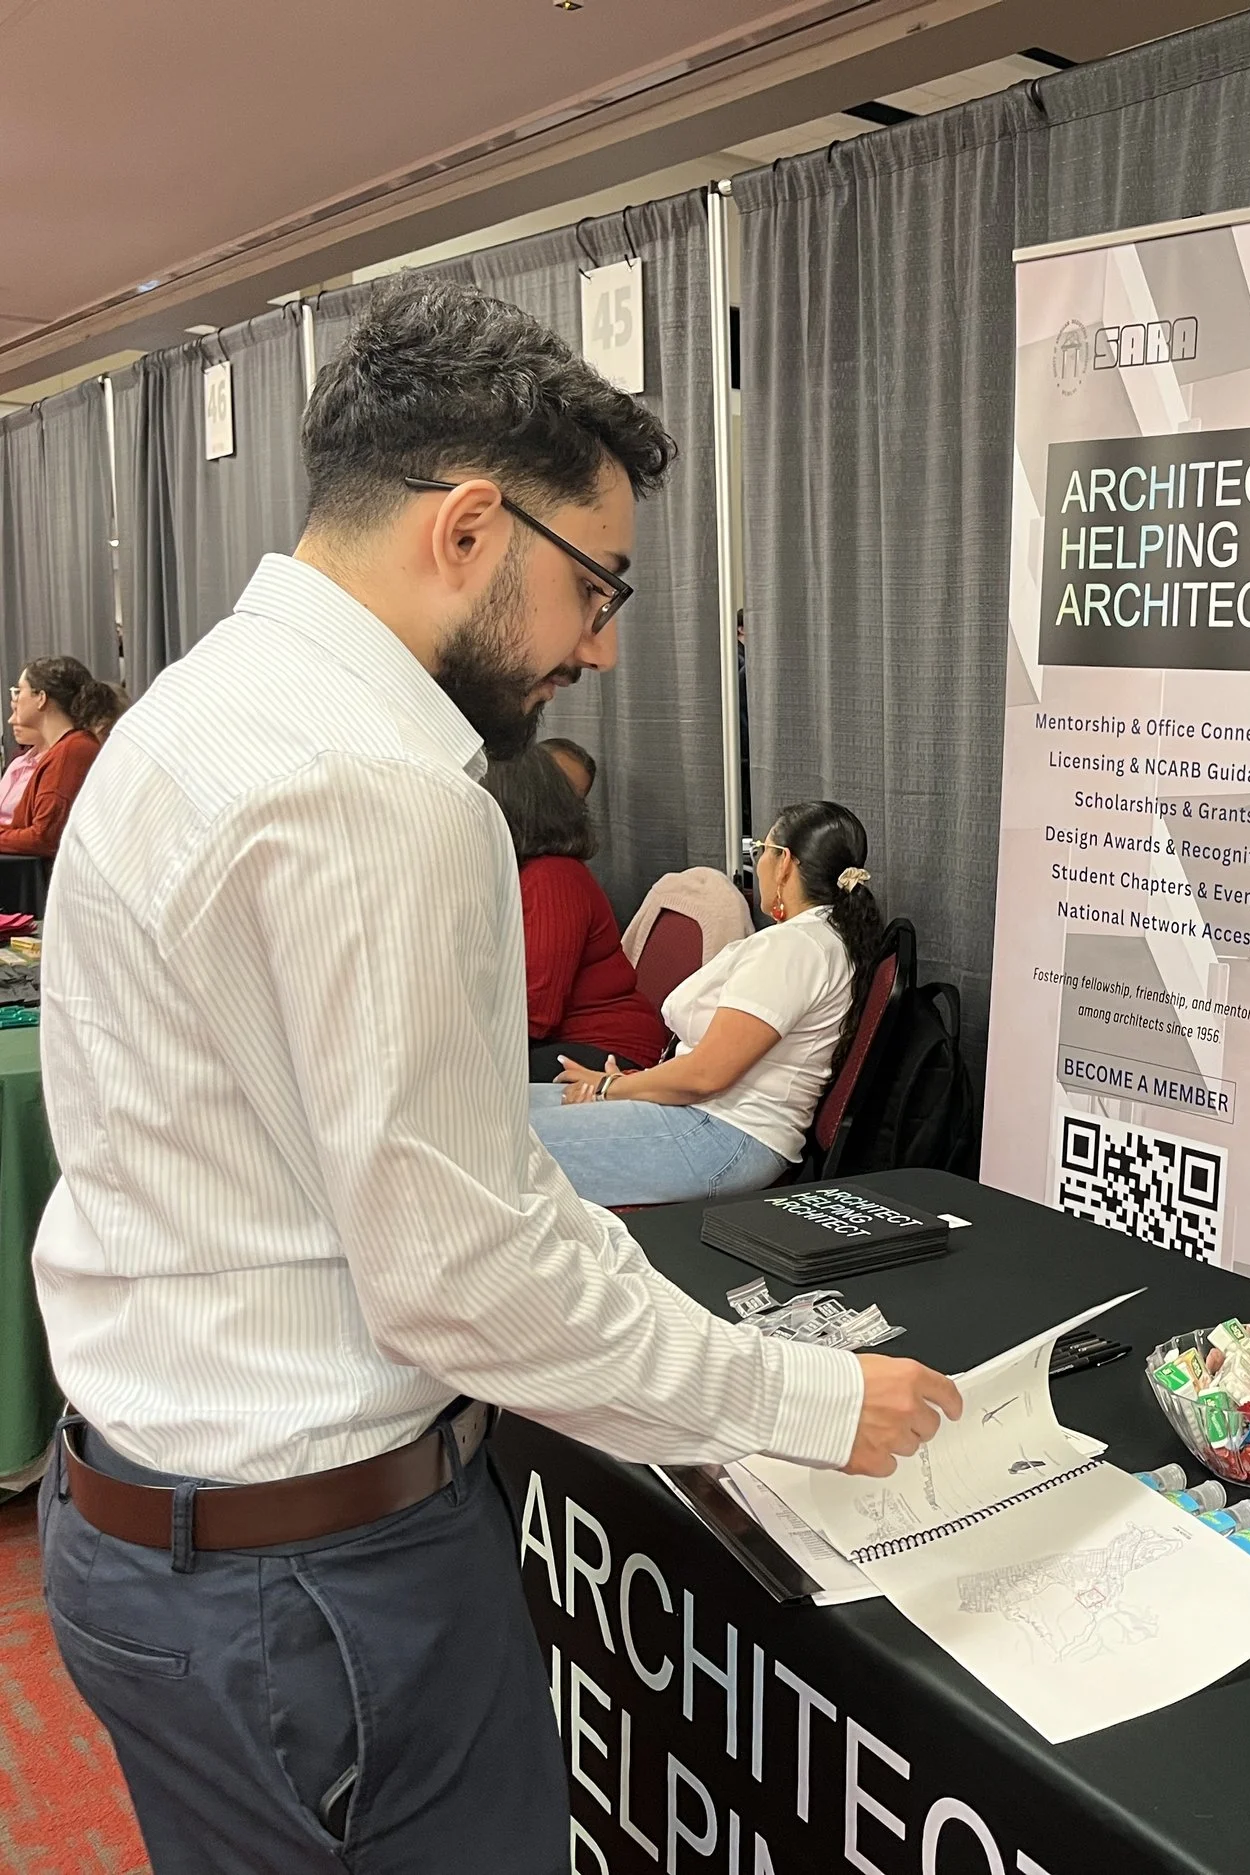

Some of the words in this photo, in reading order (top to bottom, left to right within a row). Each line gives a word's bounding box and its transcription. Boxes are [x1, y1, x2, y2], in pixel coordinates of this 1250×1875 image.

[592, 285, 632, 350] 45
[1093, 316, 1198, 370] SARA
[208, 380, 227, 424] 46
[1061, 521, 1238, 570] HELPING
[1035, 713, 1126, 738] Mentorship
[1132, 719, 1142, 735] &
[1146, 719, 1195, 738] Office
[1049, 751, 1124, 776] Licensing
[1130, 758, 1139, 774] &
[1145, 758, 1201, 778] NCARB
[1075, 791, 1177, 819] Scholarships
[1183, 801, 1193, 818] &
[1045, 826, 1098, 849] Design
[1104, 833, 1160, 854] Awards
[1166, 839, 1176, 856] &
[1052, 864, 1115, 886] Student
[1121, 872, 1192, 897] Chapters
[1198, 882, 1208, 898] &
[1058, 901, 1125, 926] National
[1130, 911, 1196, 937] Network
[1033, 967, 1078, 990] Fostering
[1081, 975, 1132, 1000] fellowship,
[1136, 985, 1188, 1010] friendship,
[1192, 996, 1212, 1012] and
[1078, 1005, 1111, 1024] among
[1113, 1009, 1164, 1033] architects
[1166, 1021, 1193, 1038] since
[1064, 1058, 1132, 1089] BECOME
[1137, 1074, 1148, 1094] A
[1154, 1078, 1228, 1113] MEMBER
[764, 1198, 871, 1236] ARCHITECT
[792, 1192, 872, 1223] HELPING
[816, 1189, 923, 1227] ARCHITECT
